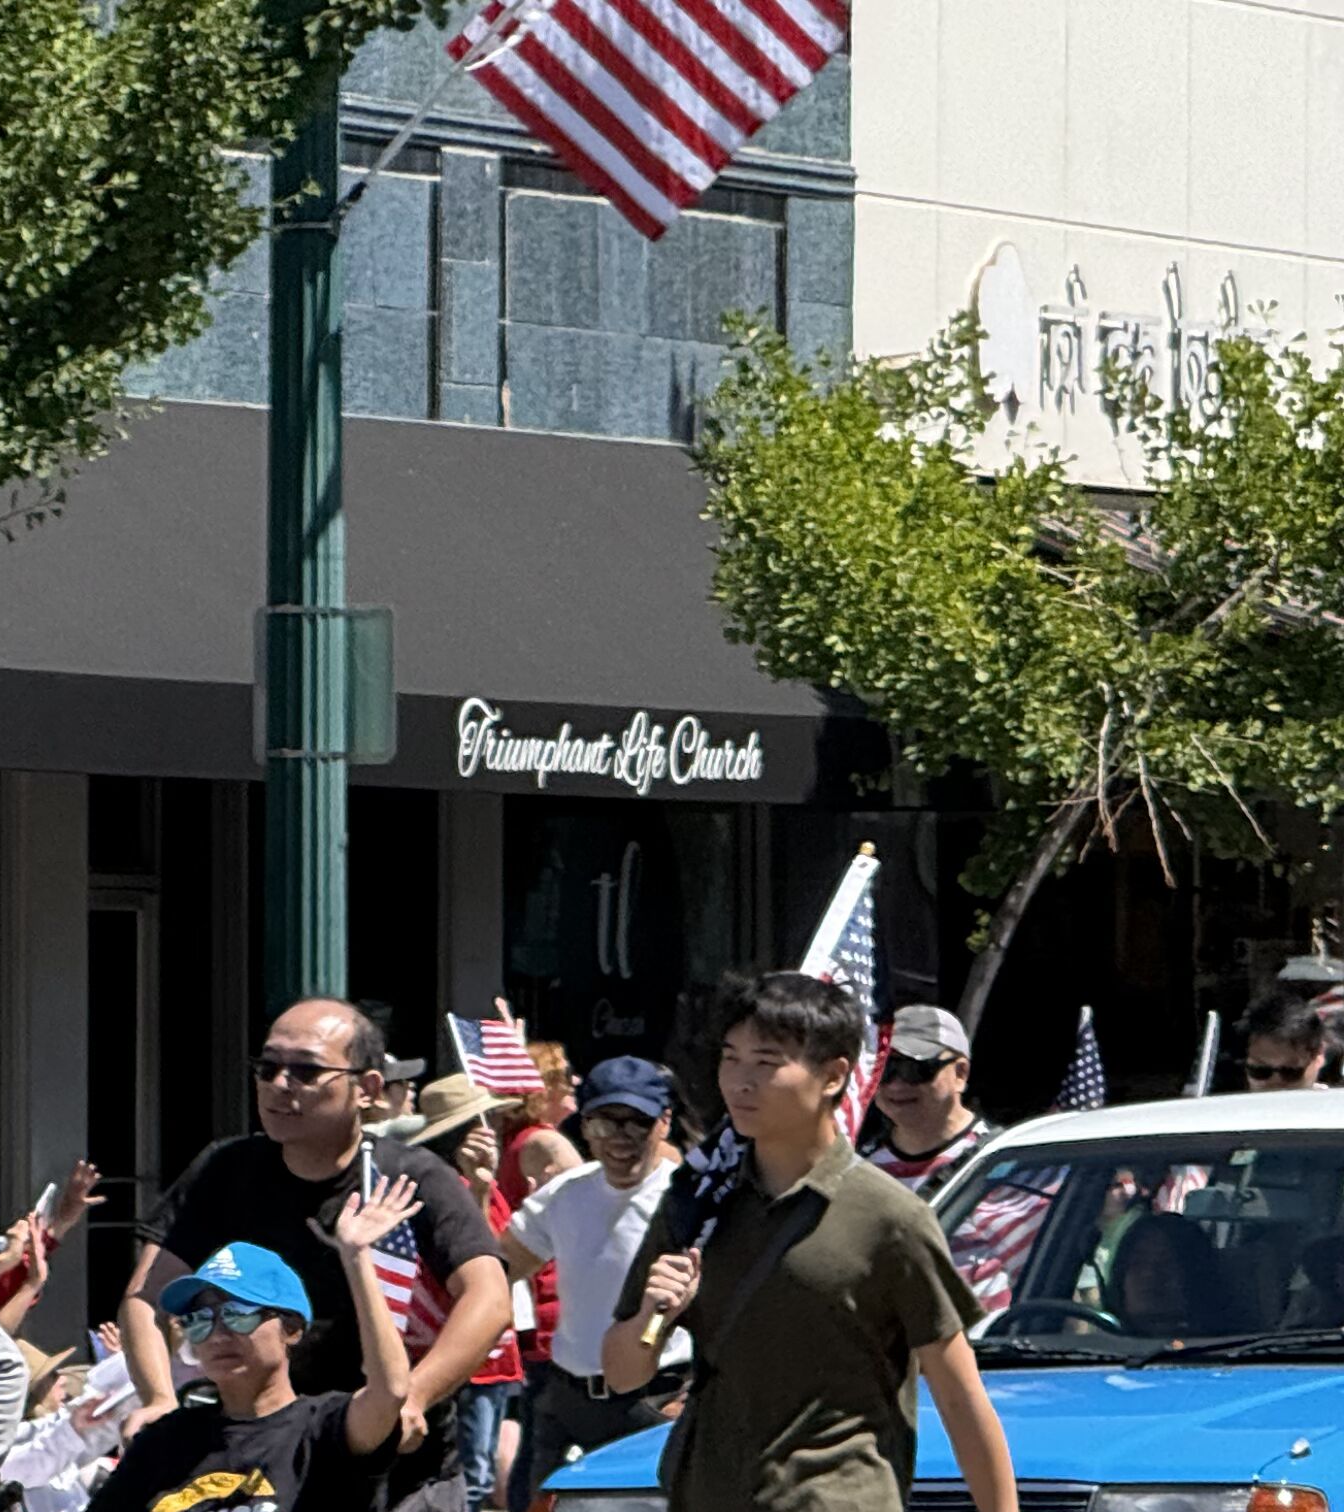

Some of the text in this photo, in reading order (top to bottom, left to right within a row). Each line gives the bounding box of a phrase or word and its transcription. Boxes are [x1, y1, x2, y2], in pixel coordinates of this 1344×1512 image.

[457, 697, 763, 796] Triumphant Life Church
